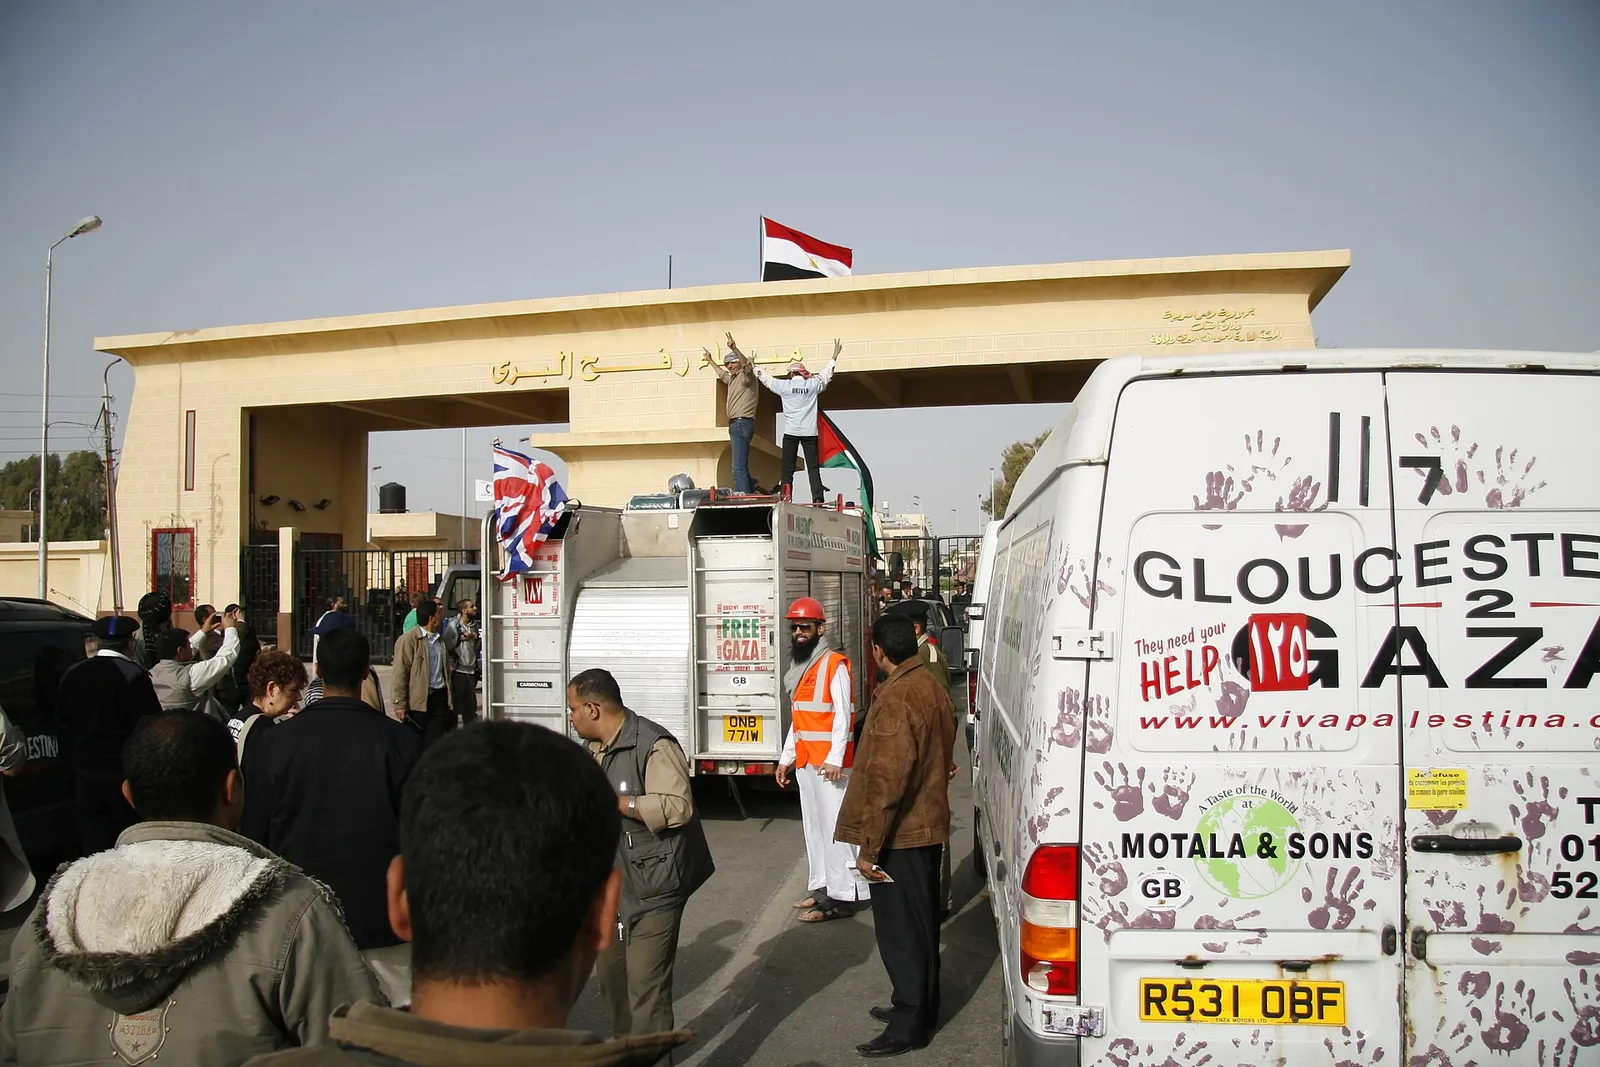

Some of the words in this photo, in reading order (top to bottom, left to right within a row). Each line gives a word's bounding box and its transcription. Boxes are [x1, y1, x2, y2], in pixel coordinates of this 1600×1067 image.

[580, 347, 690, 382] رفح
[1465, 589, 1516, 619] 2
[723, 619, 760, 639] FREE
[1134, 638, 1164, 657] They
[1167, 627, 1195, 649] need
[1200, 622, 1227, 644] your
[723, 640, 760, 661] GAZA
[733, 676, 747, 685] GB
[1140, 645, 1219, 702] HELP
[727, 729, 759, 742] 771W
[729, 716, 757, 728] ONB
[1198, 804, 1208, 814] A
[1205, 789, 1234, 806] Taste
[1235, 784, 1248, 795] of
[1250, 785, 1268, 797] the
[1270, 789, 1299, 814] World
[1241, 800, 1253, 809] at
[1121, 833, 1246, 859] MOTALA
[1256, 832, 1278, 859] &
[1287, 832, 1374, 859] SONS
[1141, 879, 1182, 899] GB
[1550, 871, 1599, 899] 52
[1144, 983, 1240, 1018] R531
